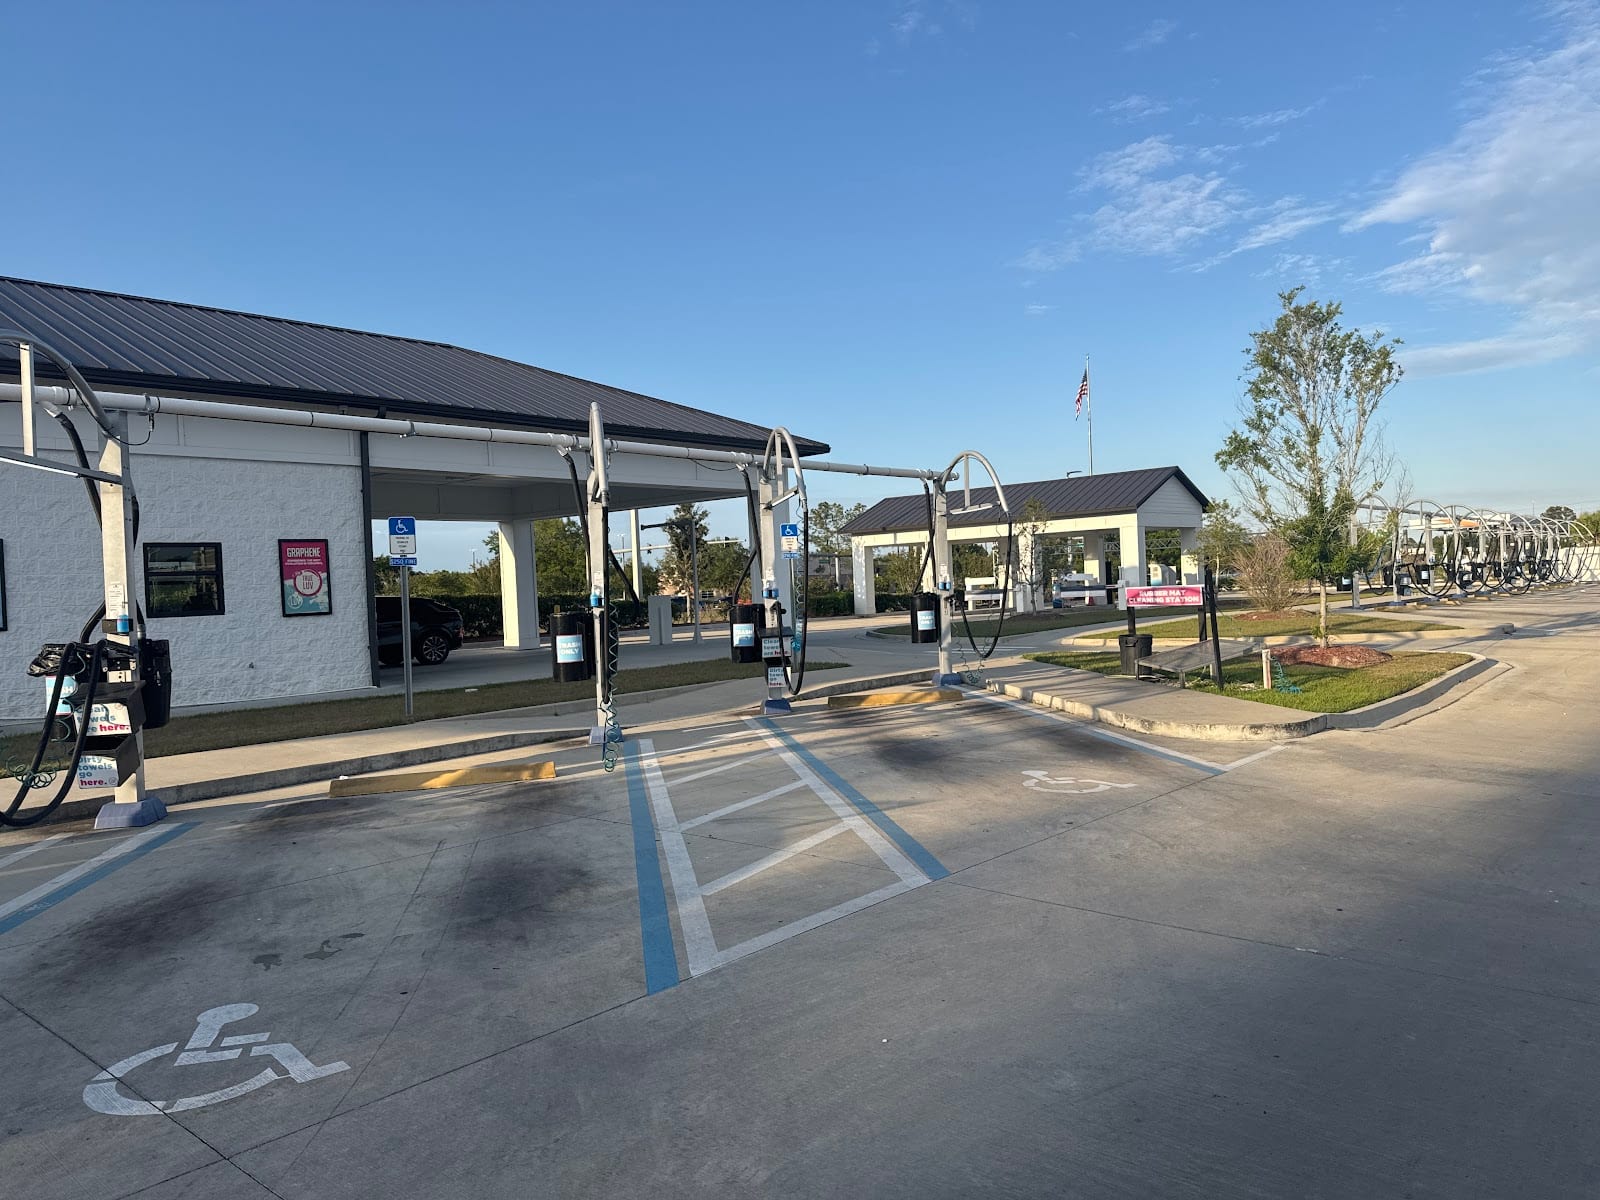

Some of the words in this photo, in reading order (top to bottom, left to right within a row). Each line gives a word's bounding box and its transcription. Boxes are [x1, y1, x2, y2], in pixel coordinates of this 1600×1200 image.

[286, 547, 321, 558] GRAPHENE
[302, 581, 314, 590] LUV
[99, 724, 129, 732] here.
[78, 762, 113, 771] towels
[79, 771, 93, 779] go
